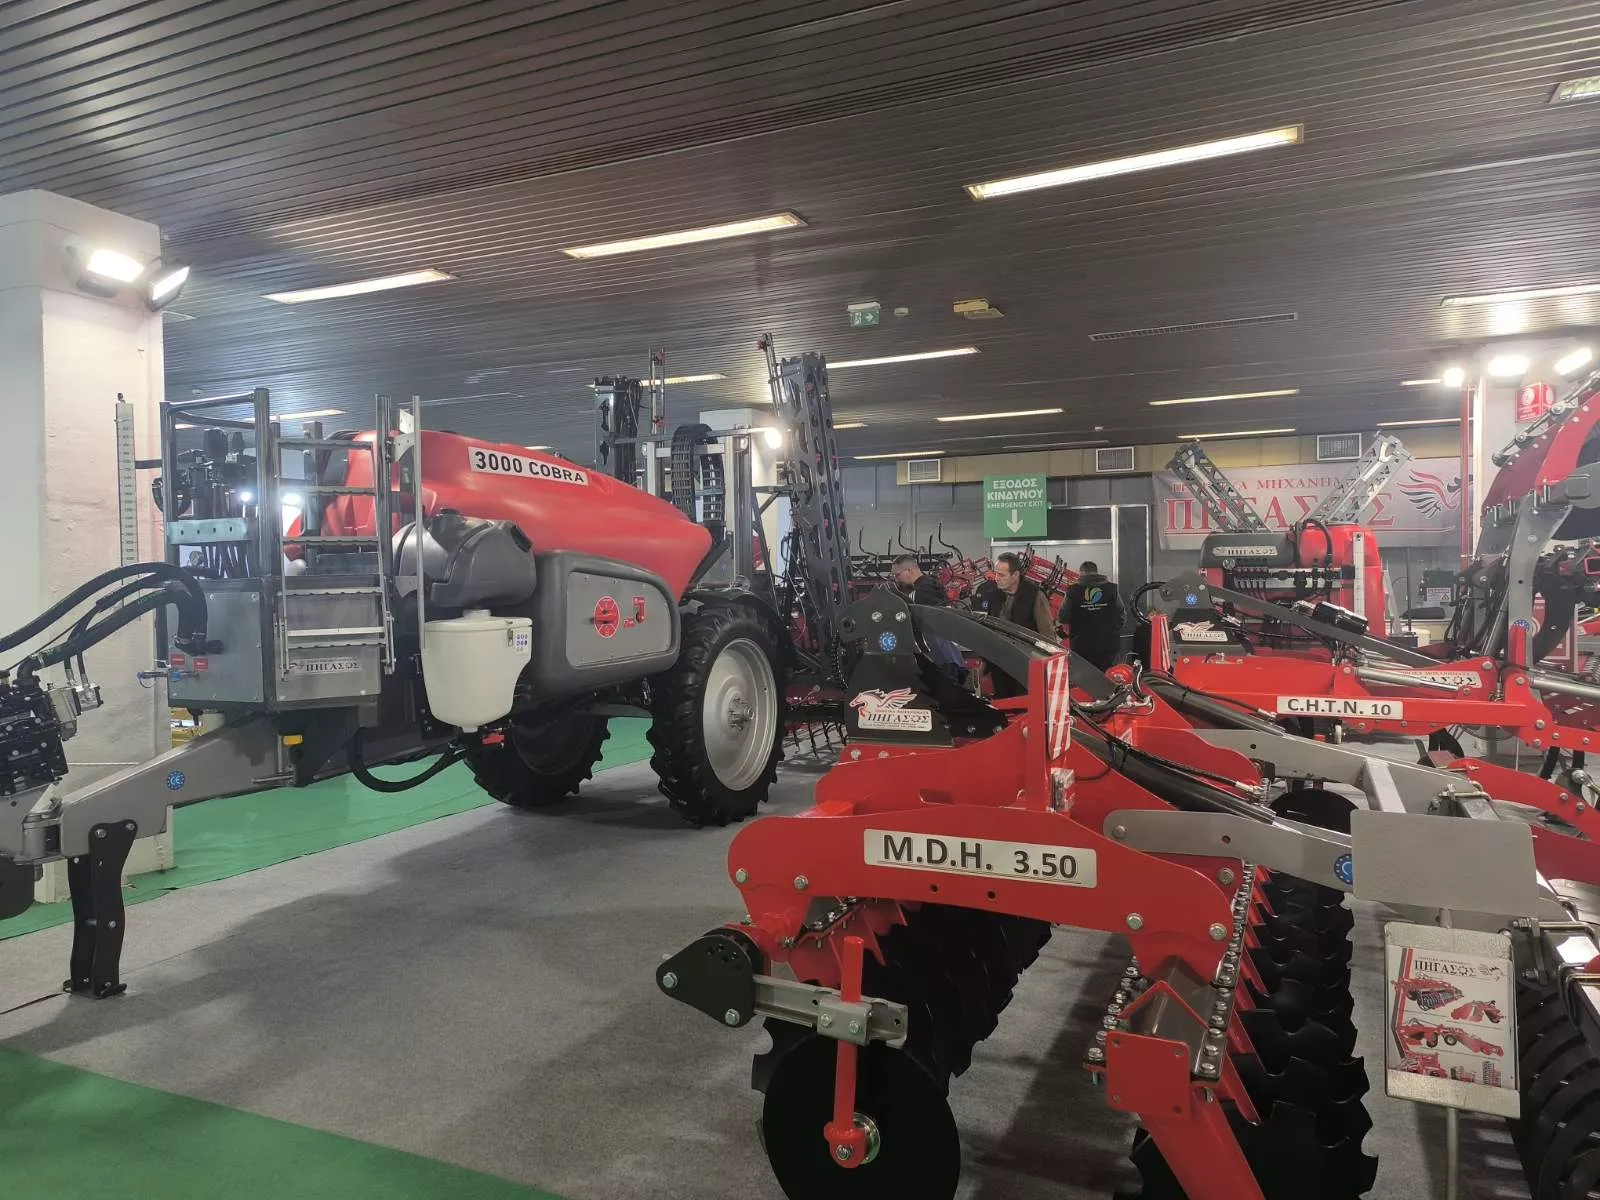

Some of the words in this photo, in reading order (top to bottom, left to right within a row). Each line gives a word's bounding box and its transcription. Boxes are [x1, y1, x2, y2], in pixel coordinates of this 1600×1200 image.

[474, 450, 523, 474] 3000
[528, 460, 585, 483] COBRA
[992, 478, 1038, 490] ΕΞΟΔΟΣ
[986, 488, 1044, 501] ΚΙΝΔΥΝΟΥ
[1028, 500, 1043, 508] EXIT
[1286, 698, 1364, 715] C.H.T.N.
[1370, 703, 1392, 716] 10
[883, 834, 993, 870] M.D.H.
[1013, 850, 1078, 880] 3.50
